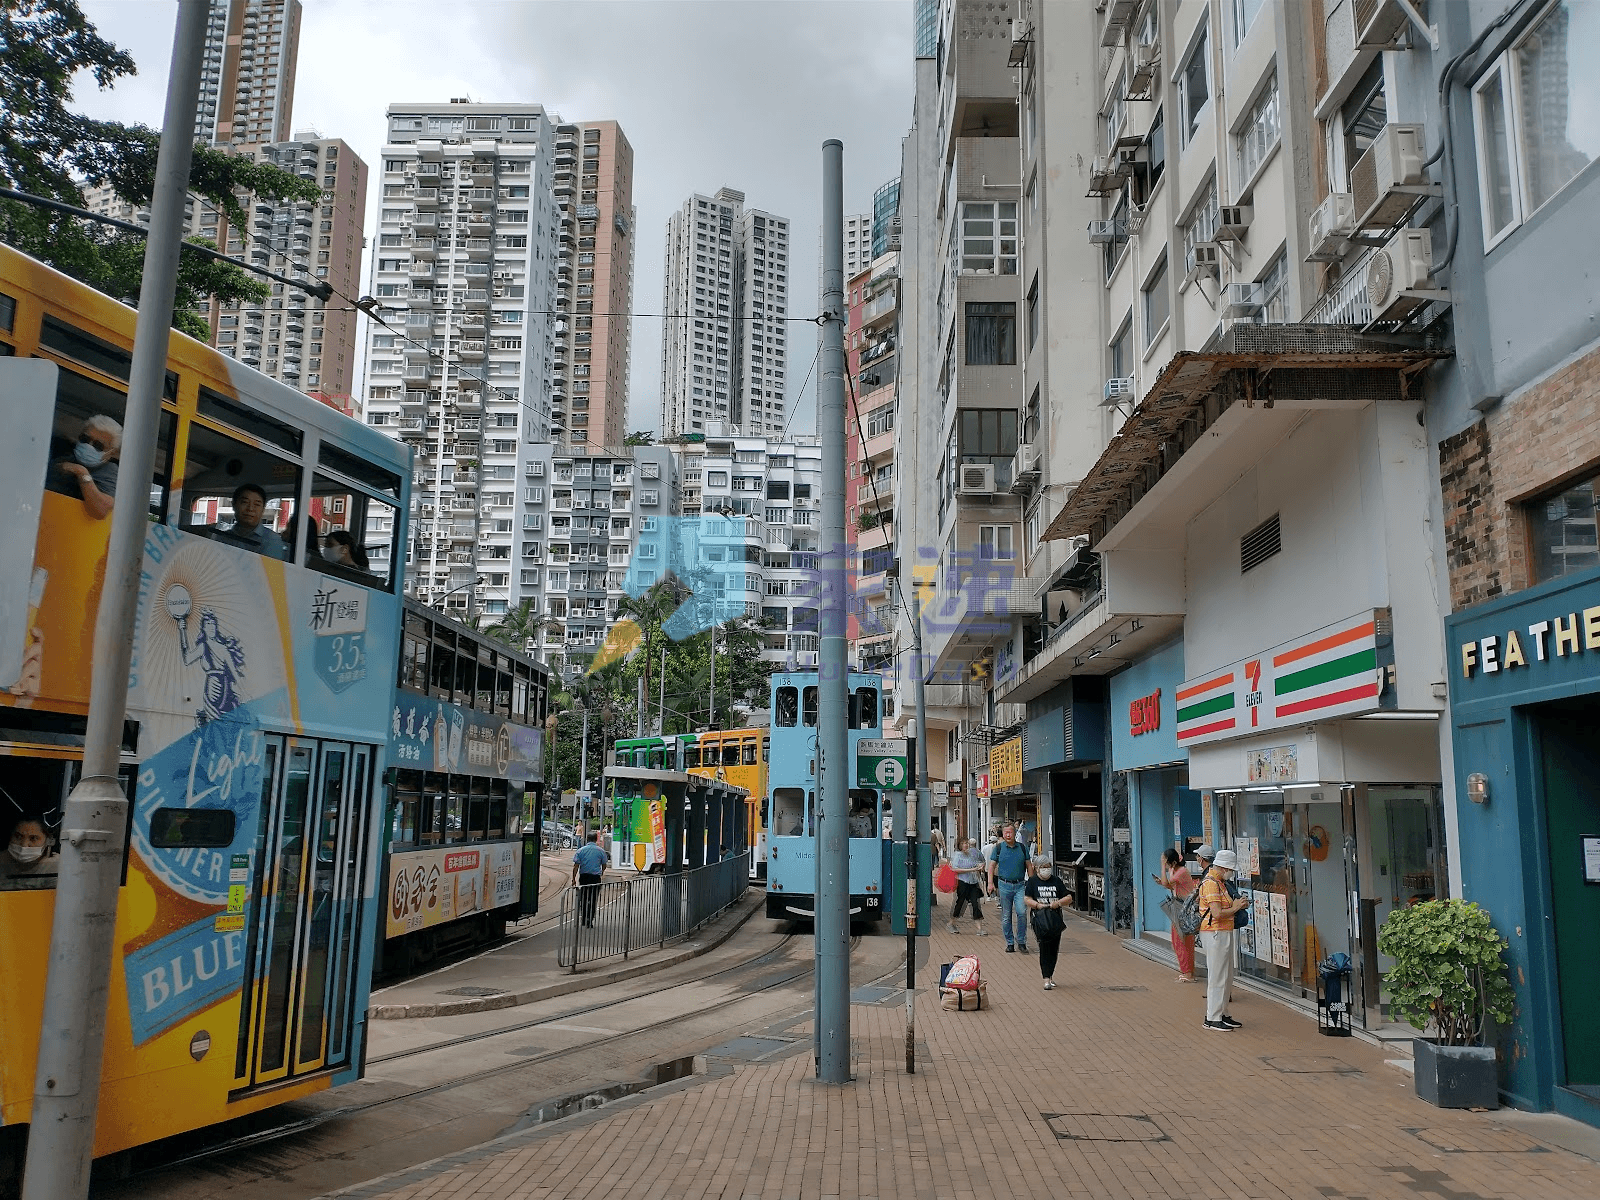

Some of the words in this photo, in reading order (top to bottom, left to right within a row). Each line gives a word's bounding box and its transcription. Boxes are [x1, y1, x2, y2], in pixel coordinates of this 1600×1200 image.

[308, 588, 359, 630] 新登場
[779, 678, 792, 686] 138
[864, 679, 876, 687] 138
[1244, 659, 1261, 728] 7
[185, 728, 262, 809] Light
[866, 897, 879, 907] 138
[141, 930, 243, 1013] BLUE
